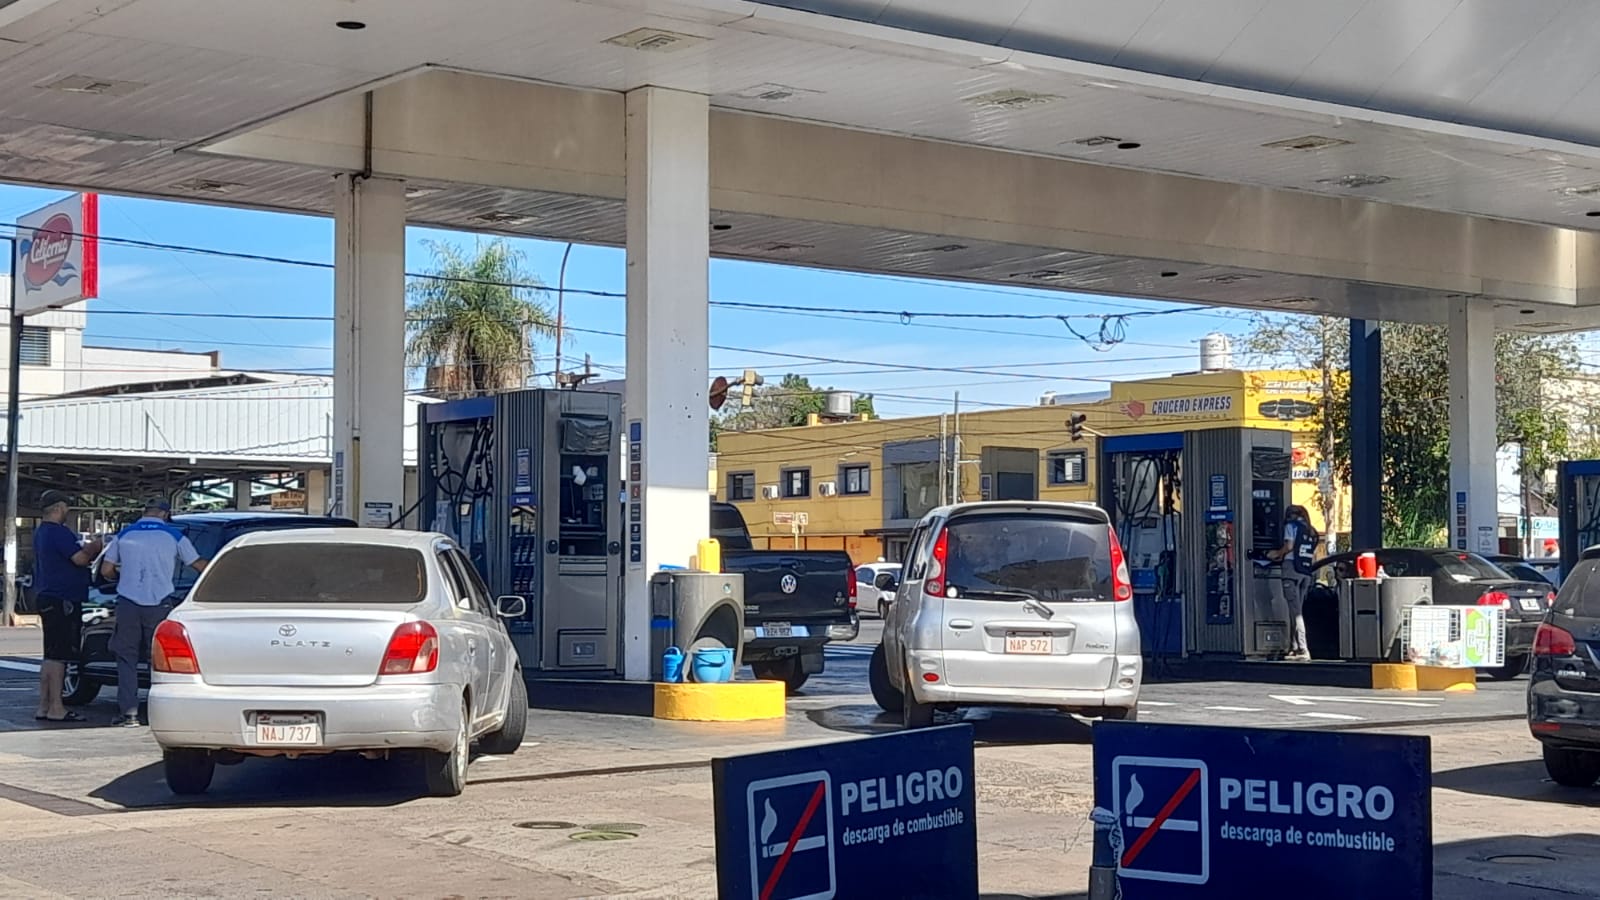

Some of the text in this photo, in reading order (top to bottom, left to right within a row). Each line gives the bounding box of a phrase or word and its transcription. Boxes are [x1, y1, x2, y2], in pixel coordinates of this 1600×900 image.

[31, 234, 68, 269] California
[1151, 395, 1232, 416] CRUCERO EXPRESS
[270, 639, 331, 648] PLATZ
[1009, 639, 1048, 651] NAP 572
[262, 726, 311, 741] NAJ 737
[840, 766, 963, 816] PELIGRO
[1219, 777, 1395, 820] PELIGRO
[842, 808, 964, 846] descarga de combustible
[1220, 821, 1395, 852] descarga de combustible
